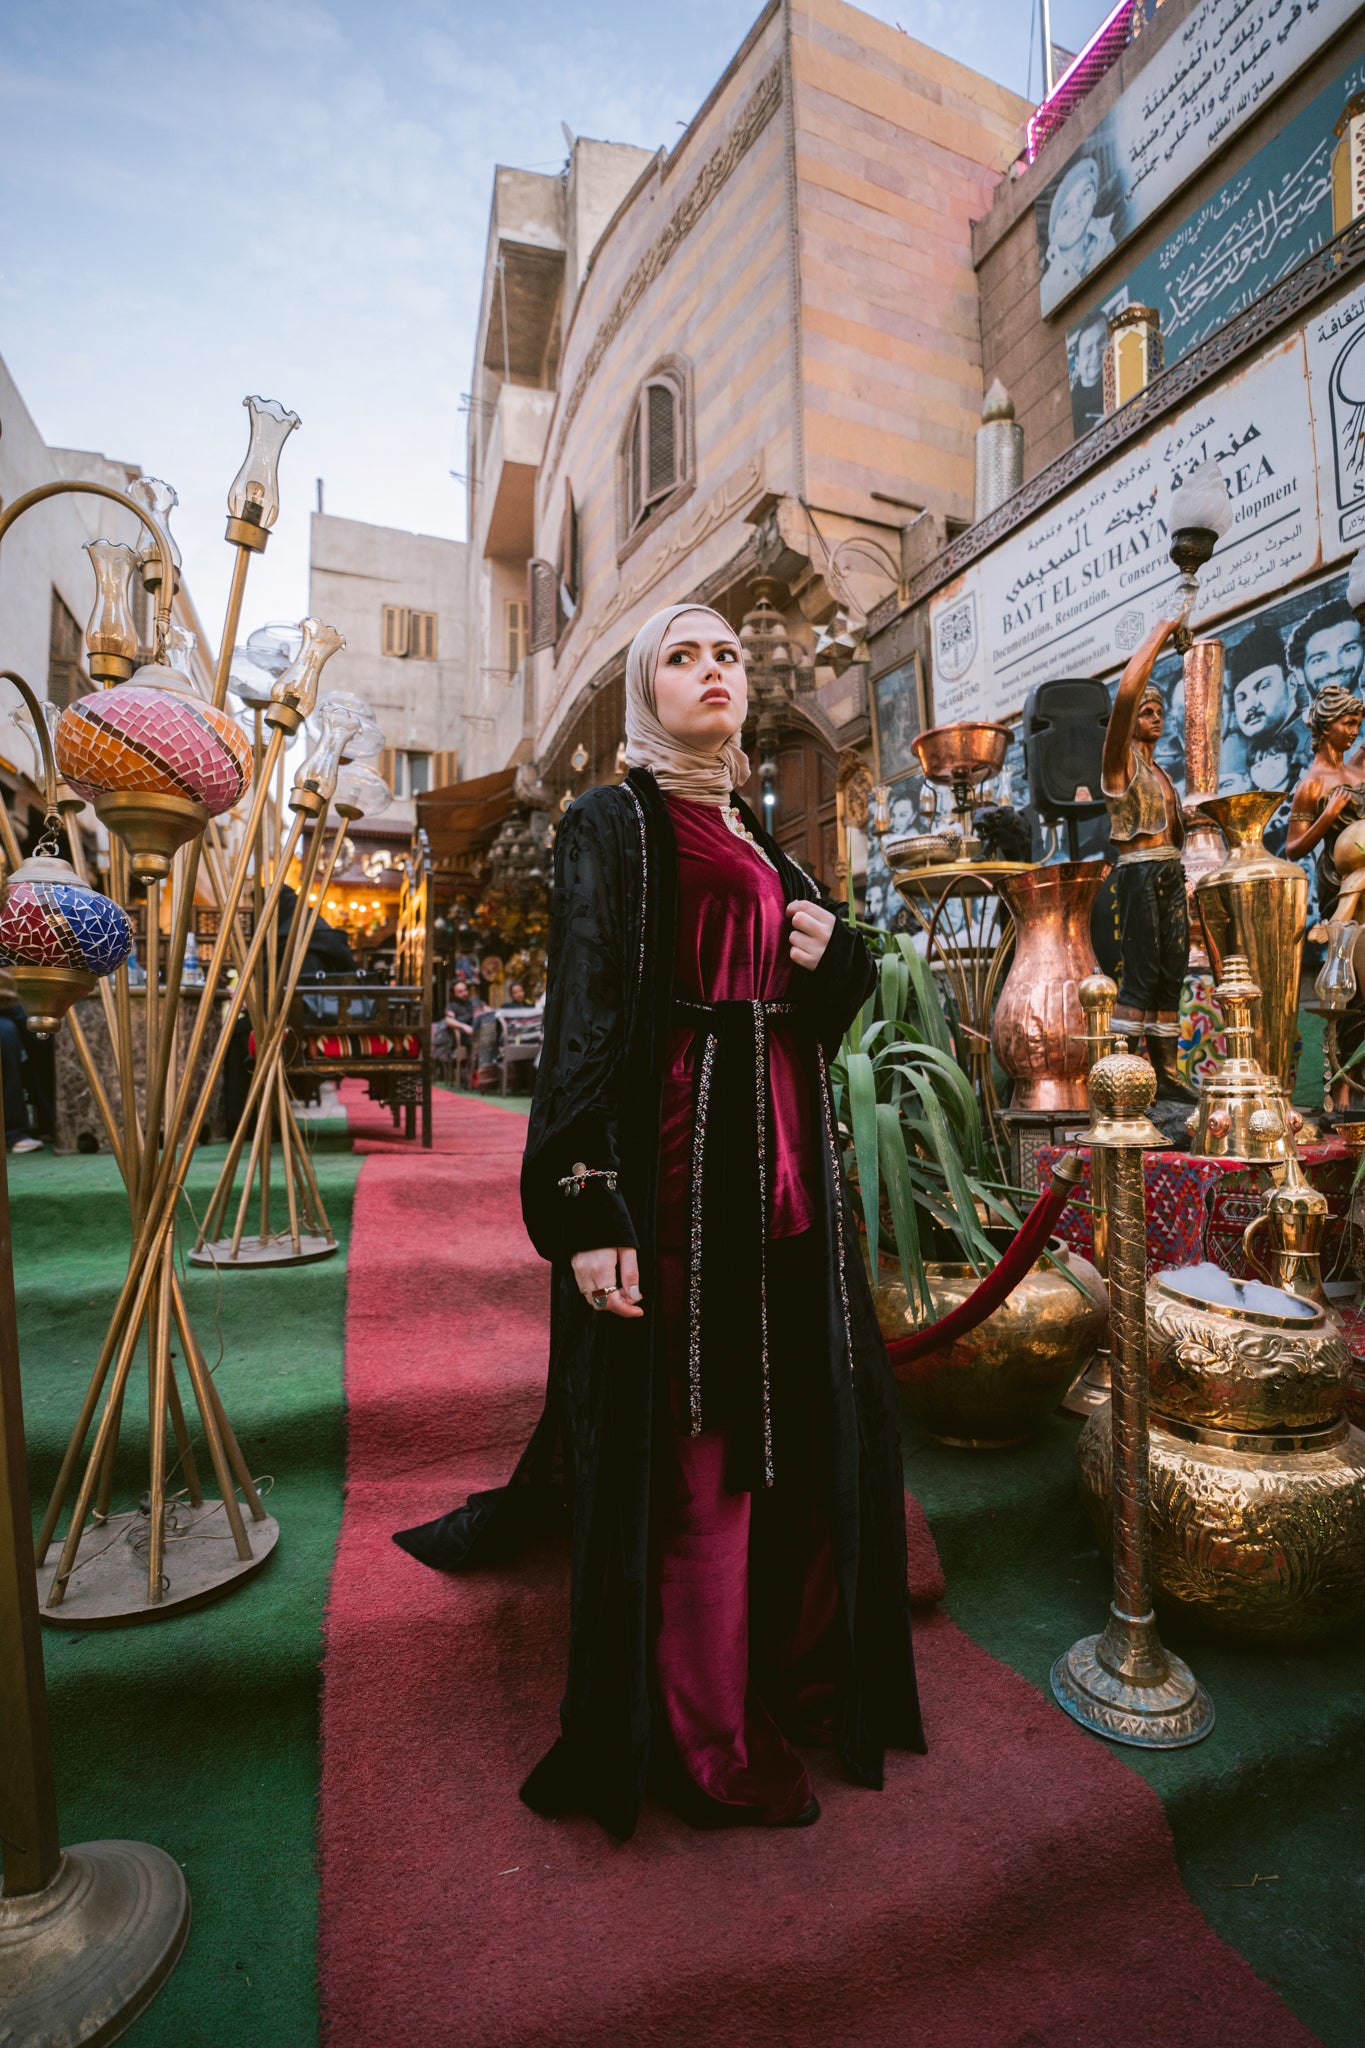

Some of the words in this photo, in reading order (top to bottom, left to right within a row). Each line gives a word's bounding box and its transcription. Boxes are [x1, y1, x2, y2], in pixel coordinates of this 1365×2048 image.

[1252, 70, 1275, 103] صدق
[1163, 416, 1216, 462] مشروع
[1111, 458, 1151, 494] توثيق
[1066, 491, 1107, 525] وترميم
[1104, 494, 1157, 535] بيت
[1002, 590, 1048, 636] BAYT
[1052, 576, 1077, 605] EL
[1223, 454, 1276, 500] REA
[1027, 522, 1063, 552] وتنمية
[1264, 523, 1302, 553] البحوث
[1228, 551, 1260, 575] وتدبير
[1237, 560, 1276, 588] المشربية
[1279, 551, 1302, 569] معهد
